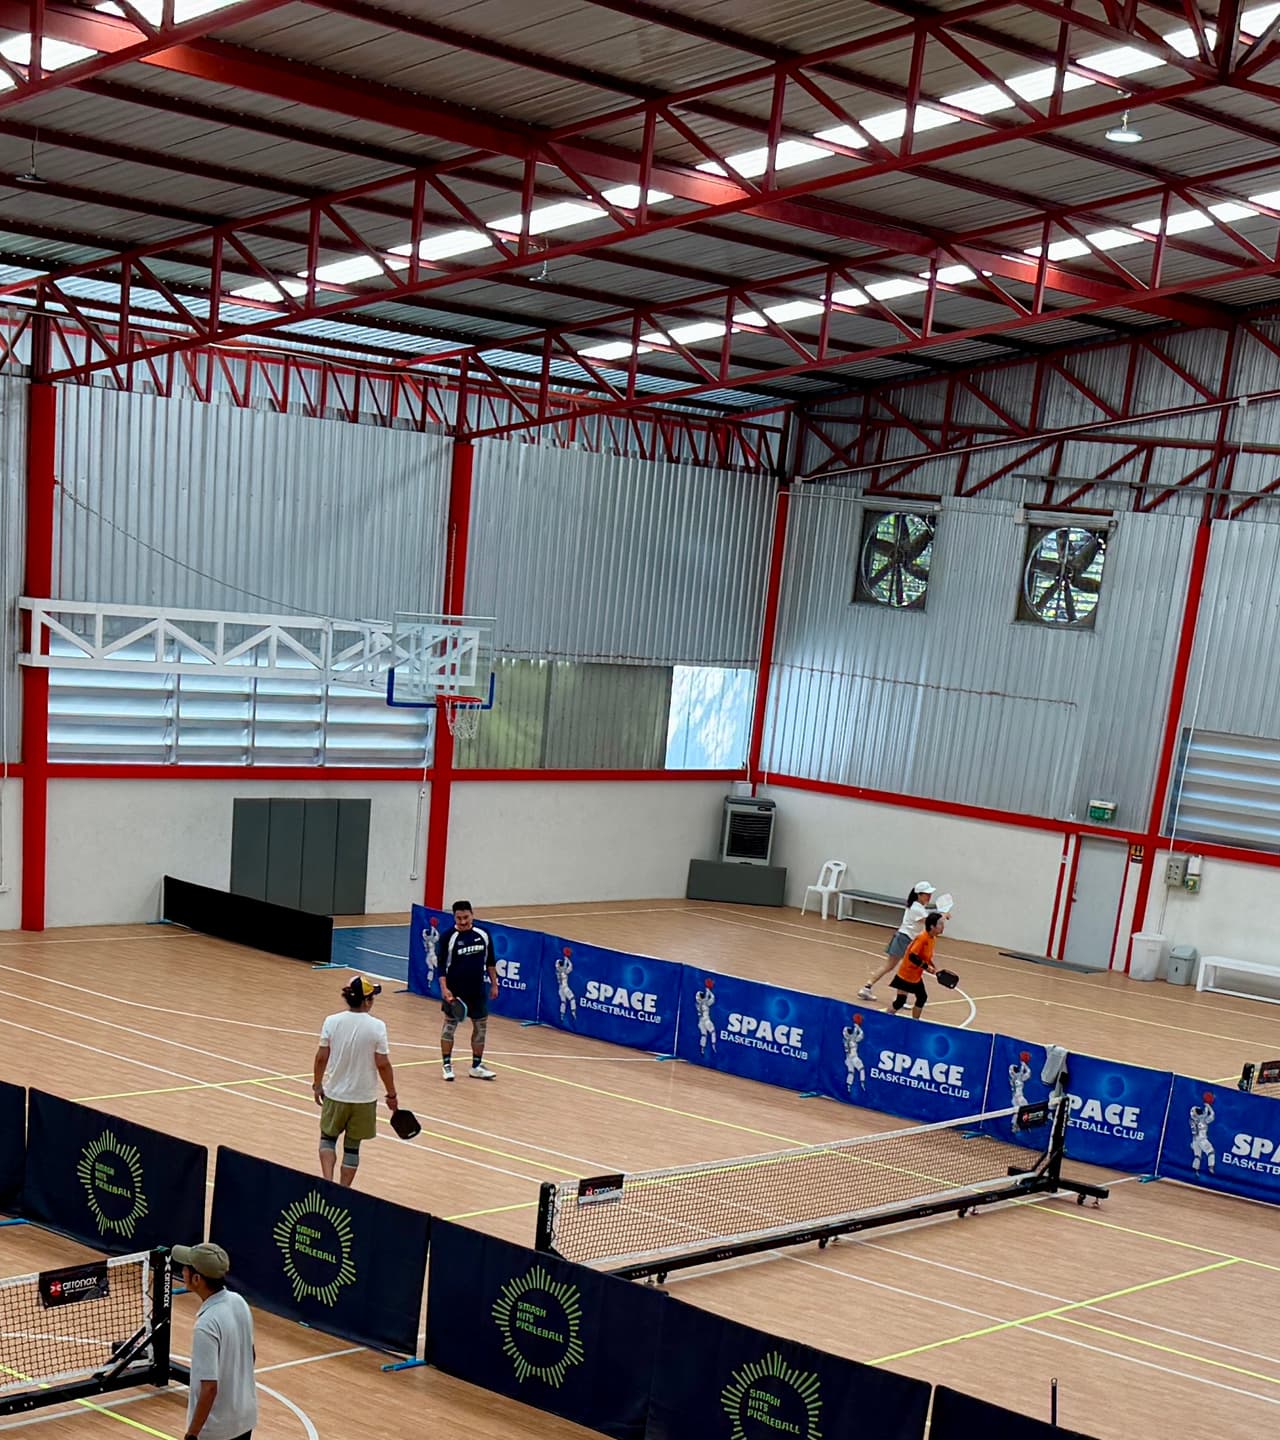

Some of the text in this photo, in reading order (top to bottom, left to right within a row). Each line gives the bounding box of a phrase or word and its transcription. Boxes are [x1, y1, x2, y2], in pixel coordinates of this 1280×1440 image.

[580, 997, 662, 1024] BASKETBALL CLUB
[585, 981, 658, 1013] SPACE
[720, 1030, 809, 1060] BASKETBALL CLUB
[727, 1013, 804, 1048] SPACE
[870, 1067, 970, 1099] BASKETBALL CLUB
[878, 1050, 965, 1087] SPACE
[1066, 1093, 1141, 1129] PACE
[1112, 1126, 1145, 1141] CLUB
[748, 1398, 769, 1412] HITS
[749, 1389, 781, 1408] SMASH
[747, 1408, 801, 1434] PICKLEBALL
